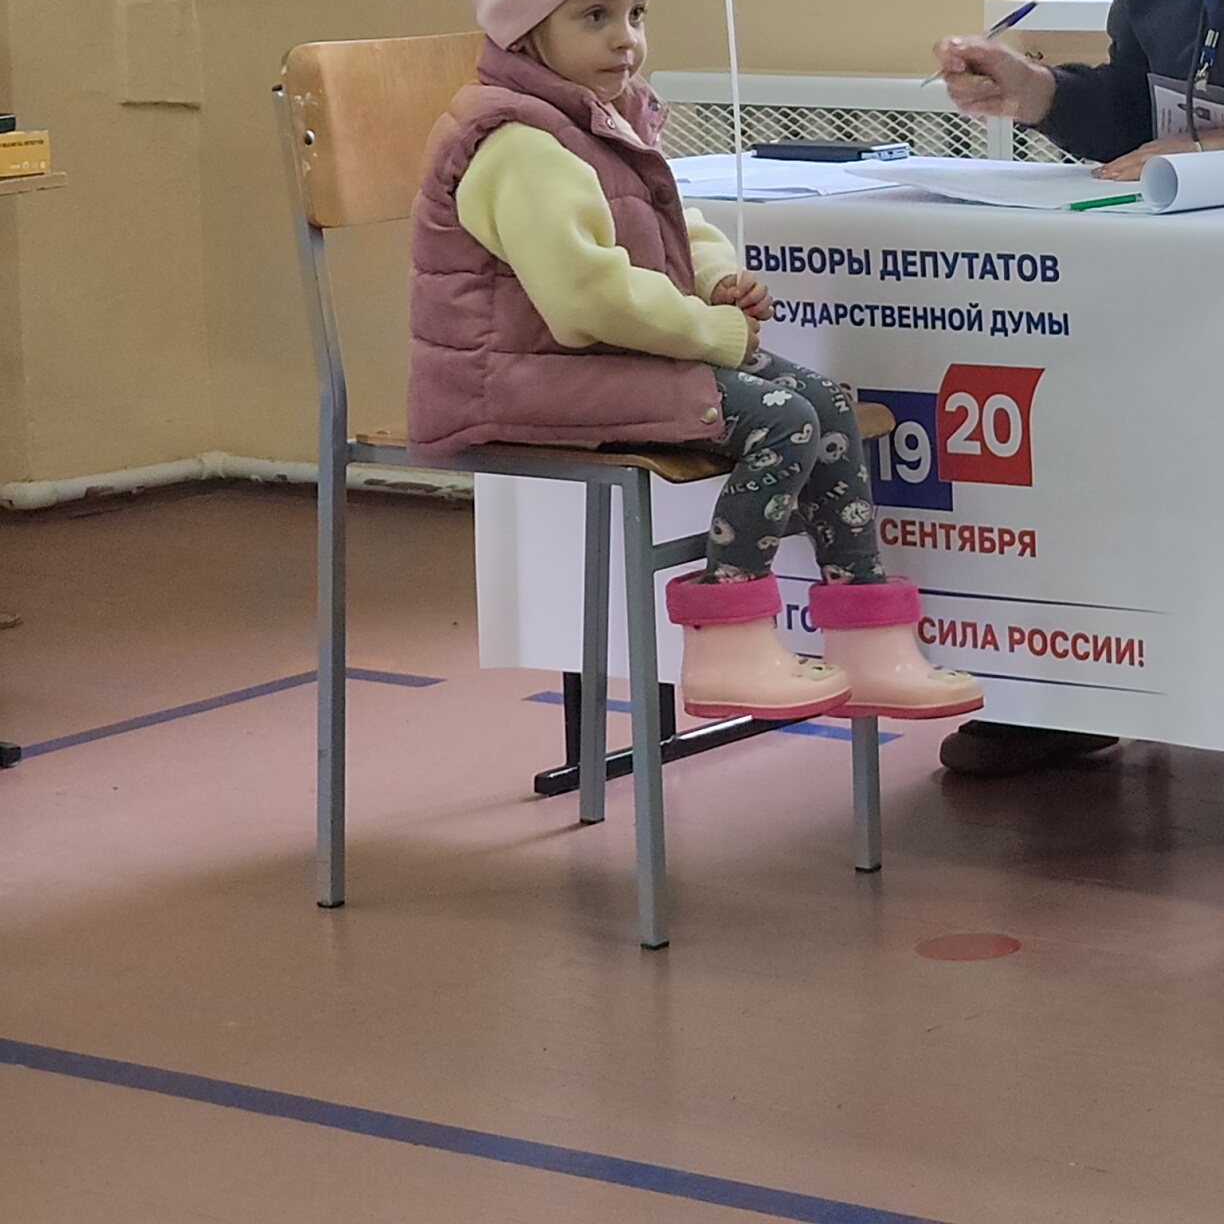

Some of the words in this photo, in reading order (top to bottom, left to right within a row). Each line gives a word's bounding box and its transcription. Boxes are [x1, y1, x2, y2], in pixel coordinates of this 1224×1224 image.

[745, 244, 871, 276] ВЫБОРЫ
[879, 249, 1060, 283] ДЕПУТАТОВ
[772, 298, 984, 334] СУДАРСТВЕННОЙ
[990, 309, 1070, 337] ДУМЫ
[944, 391, 1023, 458] 20
[876, 420, 932, 485] 19
[880, 518, 1037, 558] СЕНТЯБРЯ
[917, 618, 999, 652] СИЛА
[1008, 626, 1146, 668] РОССИИ!
